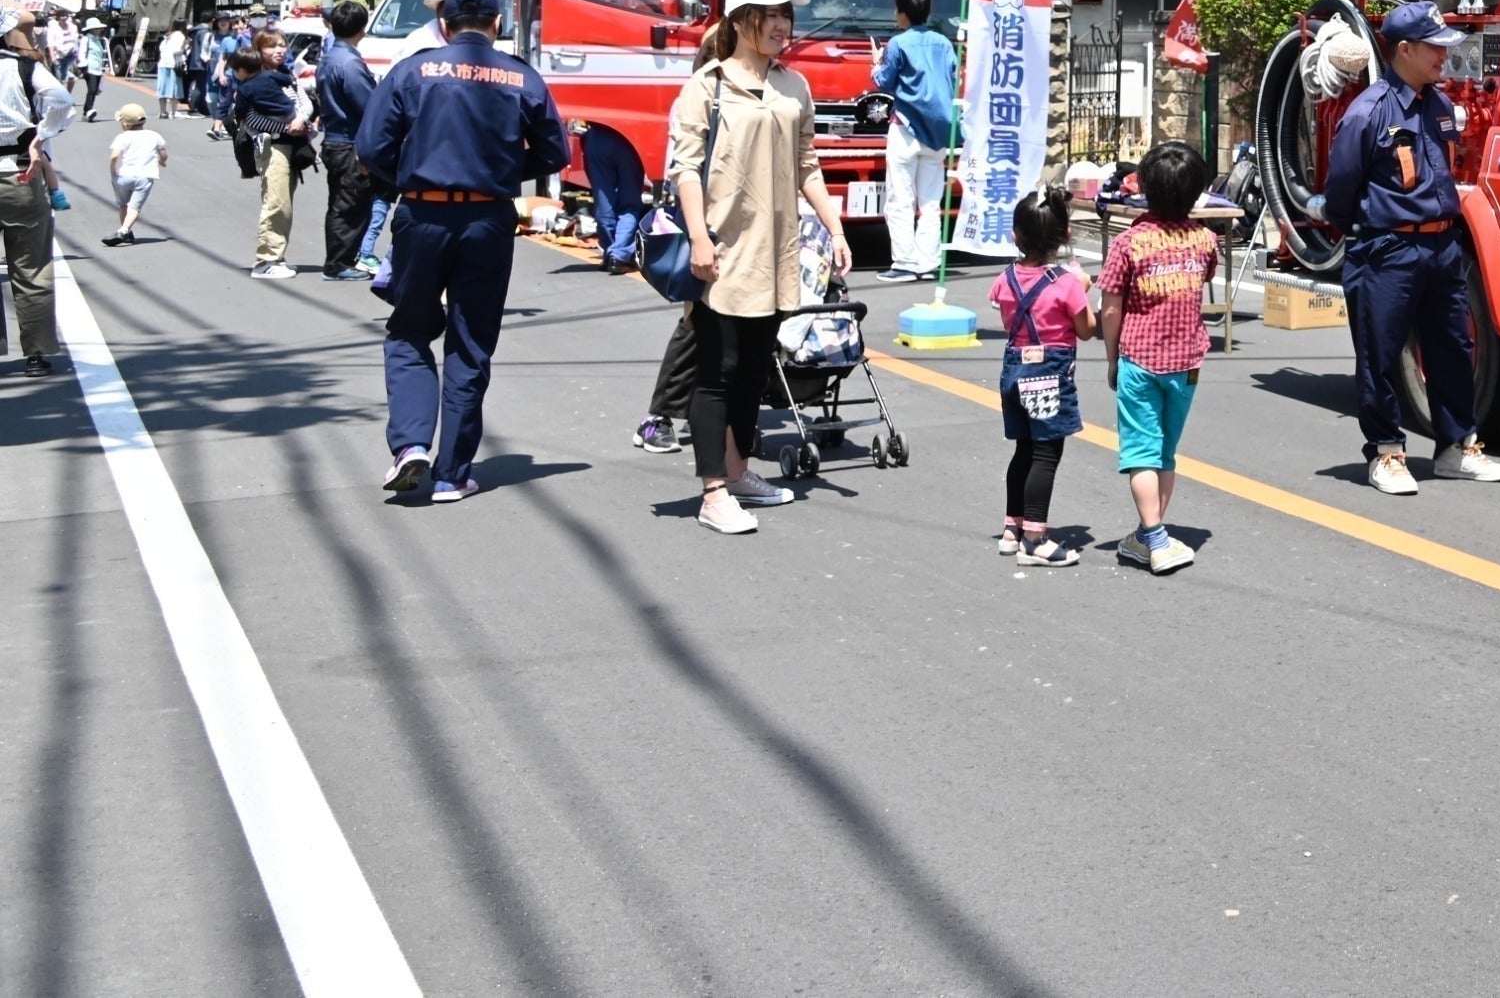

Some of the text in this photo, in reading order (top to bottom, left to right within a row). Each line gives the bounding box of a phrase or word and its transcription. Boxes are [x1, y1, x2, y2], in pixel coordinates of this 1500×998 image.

[420, 61, 524, 88] 佐久市消防団
[980, 10, 1026, 245] 消防団員募集
